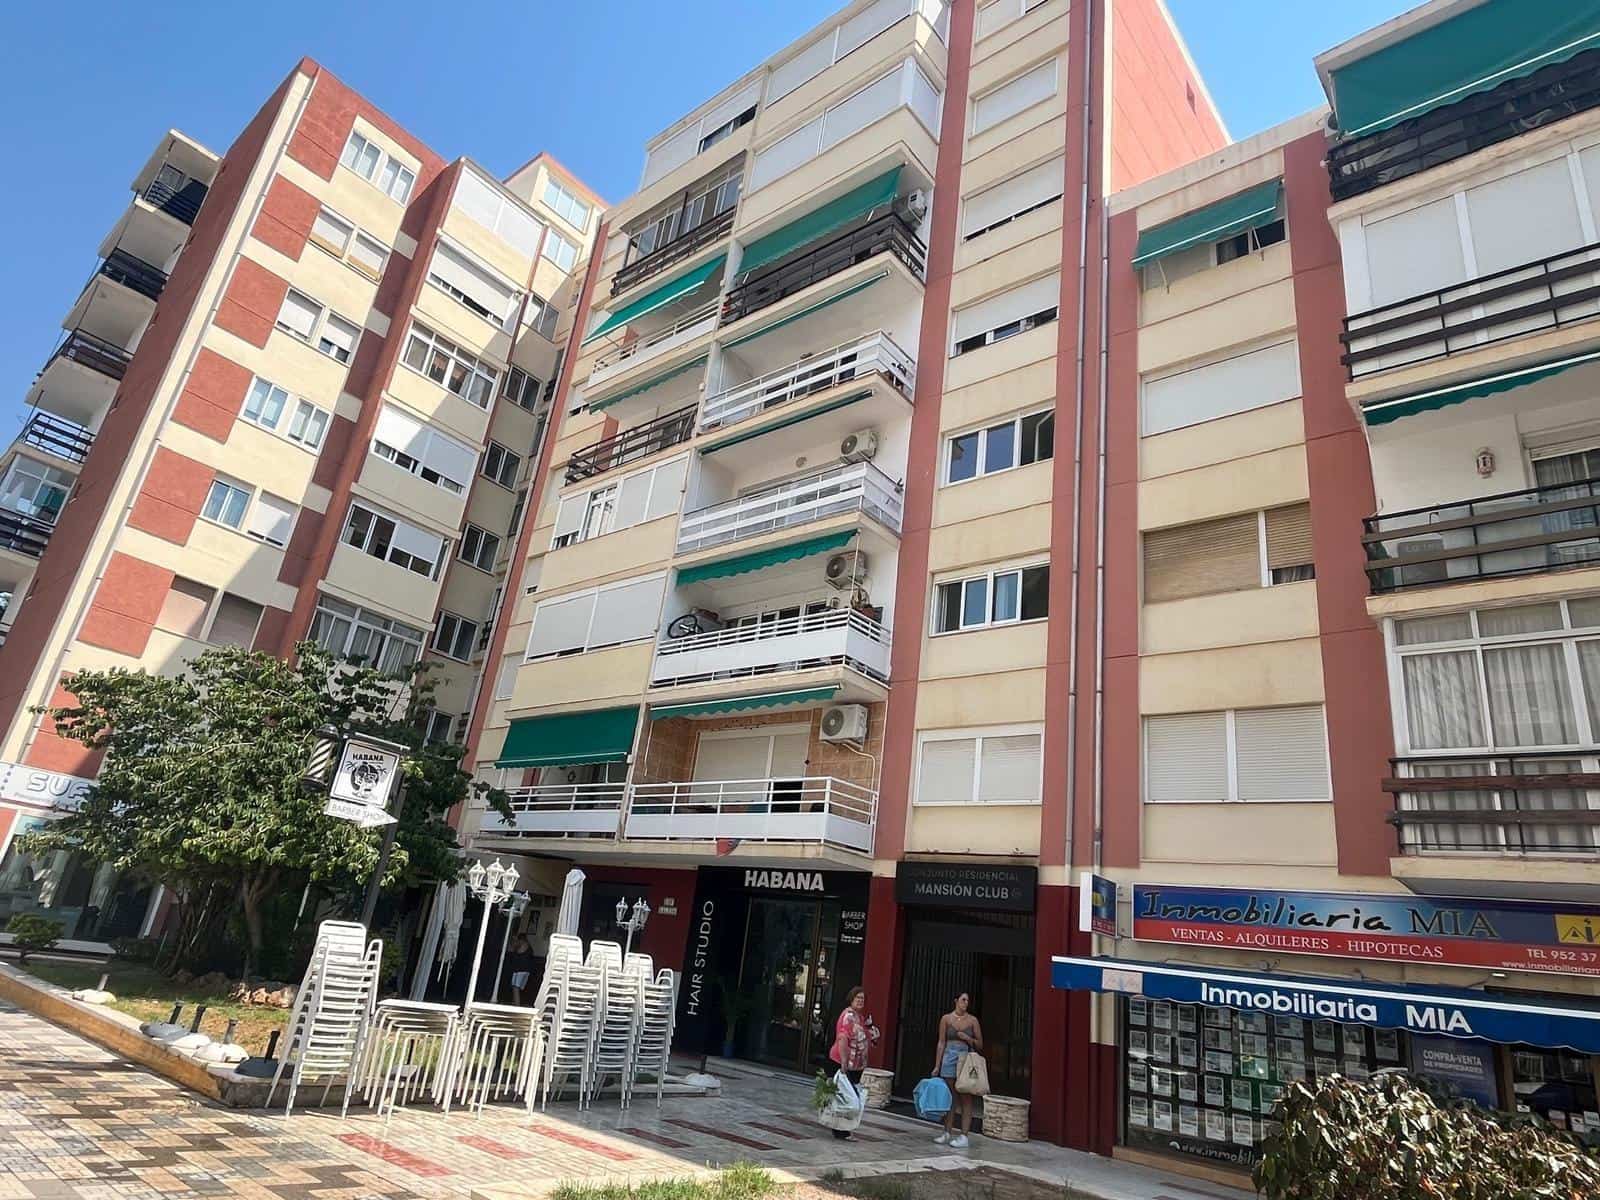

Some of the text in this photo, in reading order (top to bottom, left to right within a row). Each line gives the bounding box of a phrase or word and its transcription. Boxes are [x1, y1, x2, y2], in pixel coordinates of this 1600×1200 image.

[352, 753, 384, 761] HABANA
[744, 870, 825, 891] HABANA
[914, 882, 972, 897] MANSIÓN
[975, 886, 1009, 900] CLUB
[1141, 890, 1392, 931] Inmobiliaria
[1406, 907, 1499, 938] MIA
[1171, 927, 1224, 942] VENTAS
[1235, 932, 1329, 949] ALQUILERES
[1347, 940, 1444, 959] HIPOTECAS
[688, 900, 715, 1016] HAIR STUDIO
[1526, 948, 1597, 962] TEL 952 37
[1201, 982, 1472, 1033] Inmobiliaria MIA
[1423, 1050, 1483, 1066] COMPRA-VENTA
